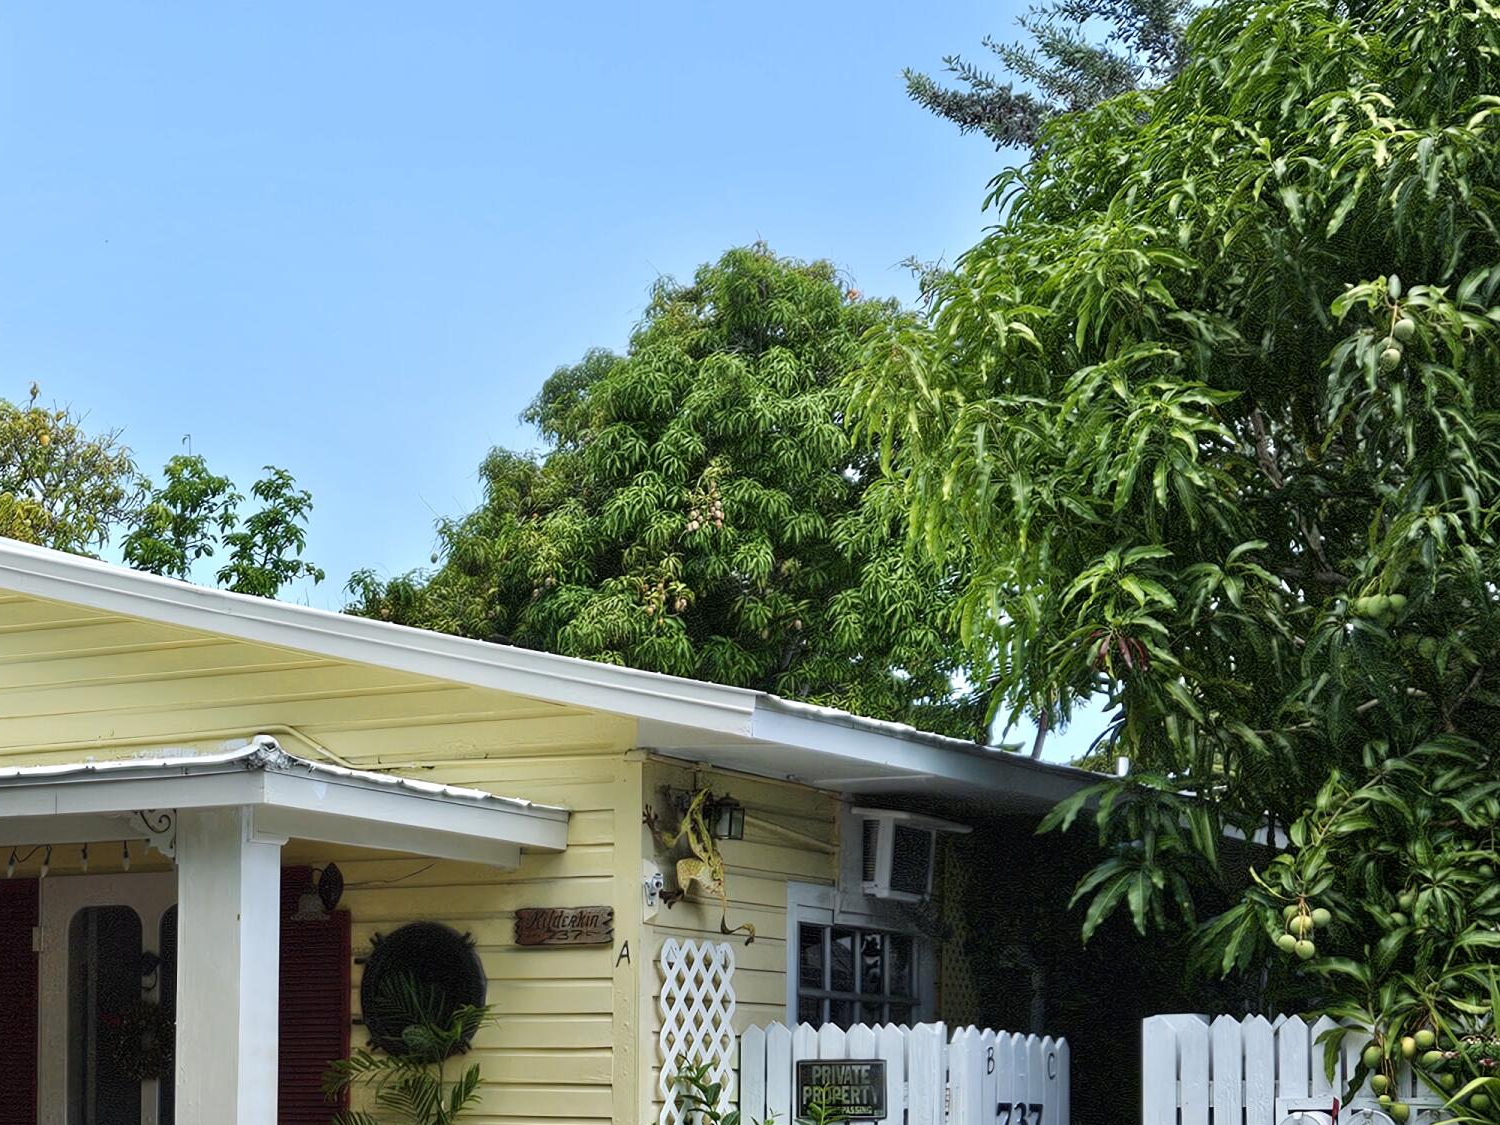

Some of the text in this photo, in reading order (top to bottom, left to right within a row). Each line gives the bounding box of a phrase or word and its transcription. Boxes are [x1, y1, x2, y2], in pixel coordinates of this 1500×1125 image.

[615, 940, 631, 968] A
[811, 1065, 871, 1085] PRIVATE
[986, 1046, 996, 1076] B
[1047, 1052, 1057, 1080] C
[802, 1085, 878, 1105] PROPERTY
